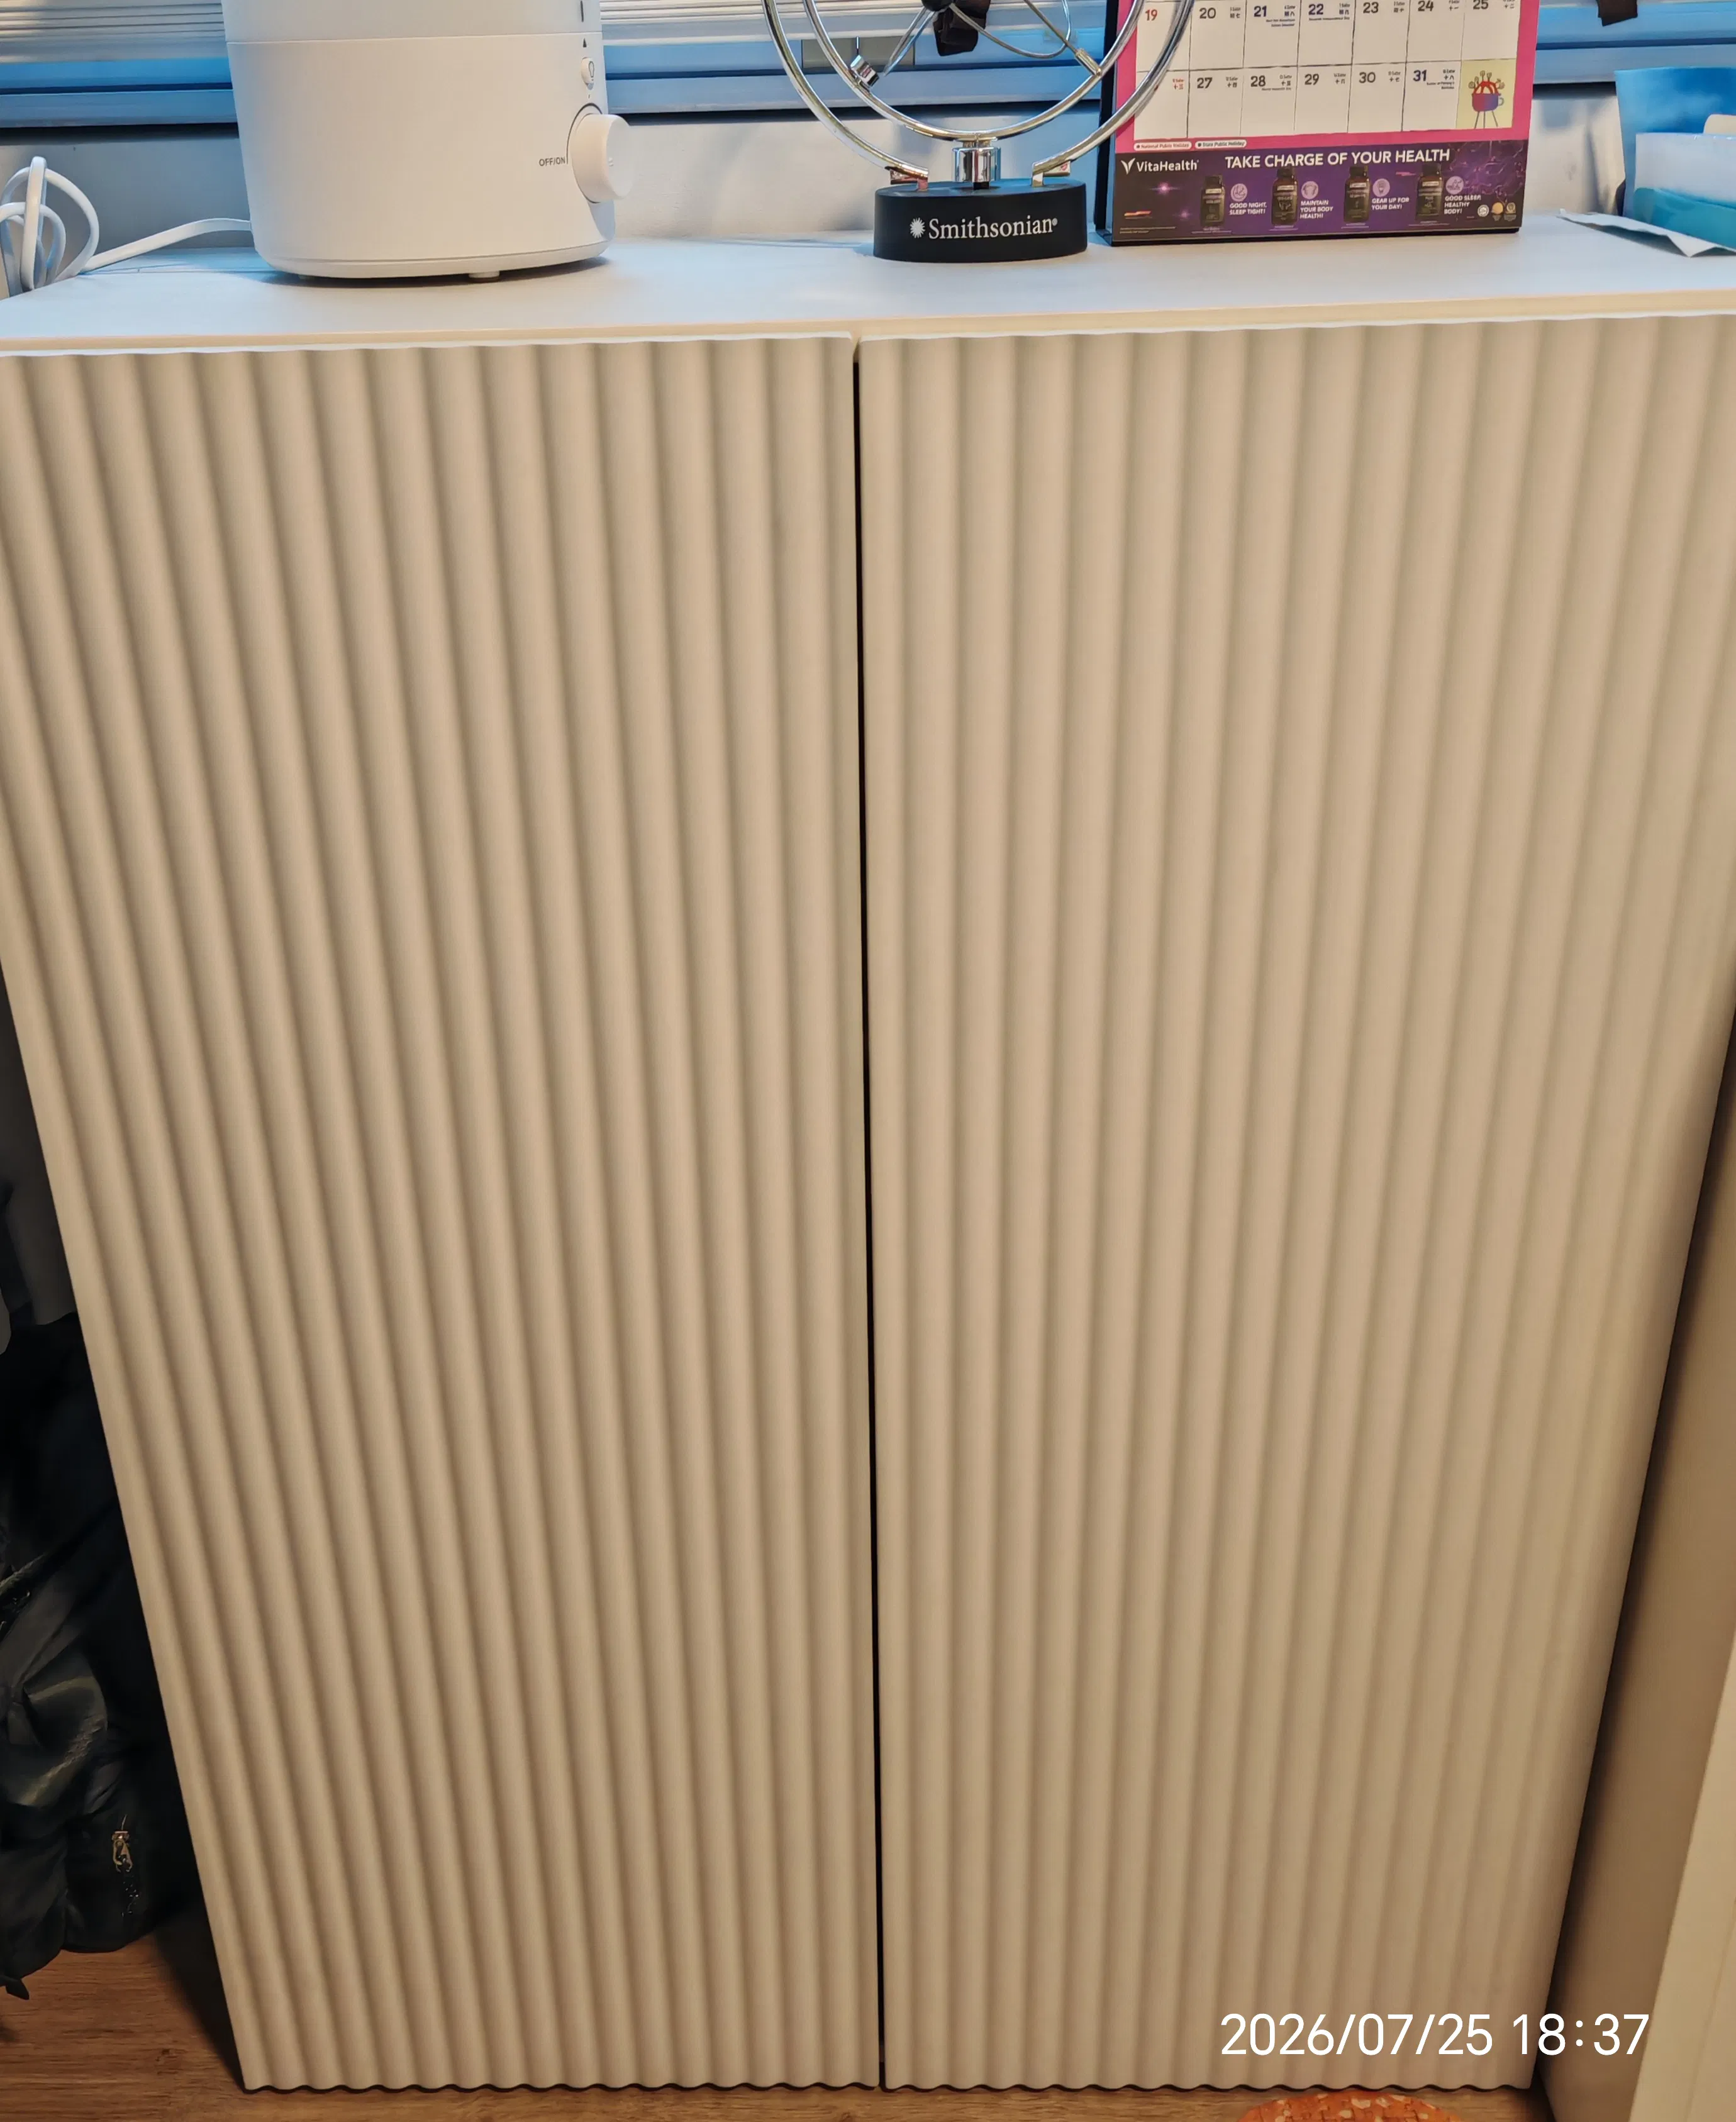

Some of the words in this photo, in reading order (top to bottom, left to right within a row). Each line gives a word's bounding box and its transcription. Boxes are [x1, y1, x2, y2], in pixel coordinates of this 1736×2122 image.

[1308, 3, 1325, 16] 22
[1363, 1, 1379, 14] 23
[1418, 0, 1434, 12] 24
[1473, 0, 1489, 10] 25
[1145, 9, 1158, 21] 19
[1199, 7, 1216, 19] 20
[1254, 5, 1267, 18] 21
[1250, 75, 1266, 87] 28
[1304, 73, 1320, 86] 29
[1359, 71, 1376, 84] 30
[1413, 69, 1427, 82] 31
[1196, 77, 1213, 89] 27
[539, 157, 565, 167] OFF/ON
[1225, 155, 1260, 169] TAKE
[1264, 153, 1323, 167] CHARGE
[1327, 152, 1348, 165] OF
[1351, 150, 1391, 165] YOUR
[1395, 148, 1450, 163] HEALTH
[1137, 160, 1197, 172] VitaHealth
[928, 215, 1054, 239] Smithsonian
